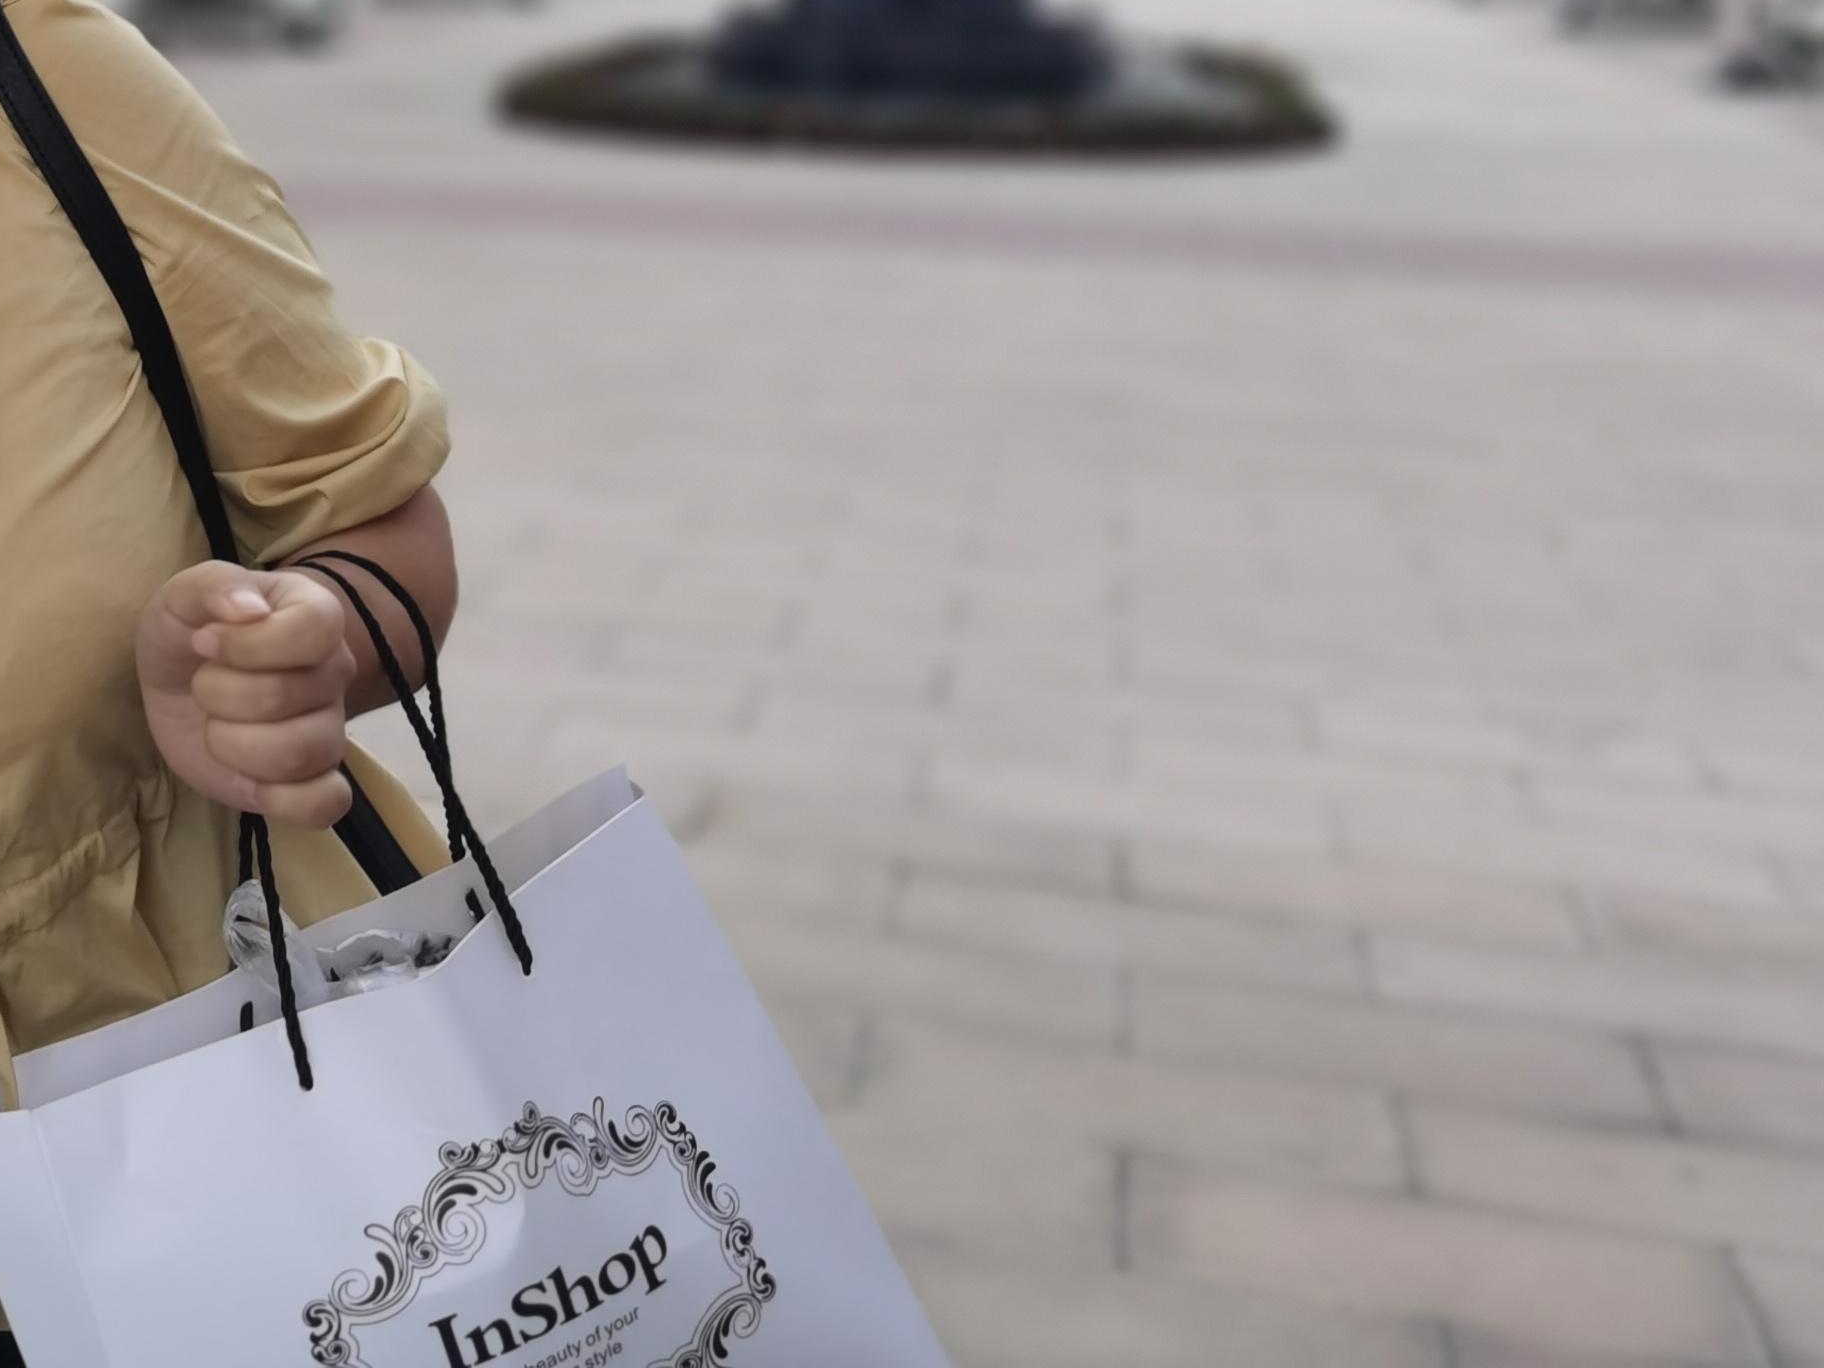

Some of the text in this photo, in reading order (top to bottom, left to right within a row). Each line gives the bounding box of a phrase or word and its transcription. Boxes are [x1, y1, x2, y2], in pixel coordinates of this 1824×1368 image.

[428, 1225, 667, 1368] InShop
[524, 1306, 640, 1368] eauty of your
[584, 1341, 622, 1368] style
